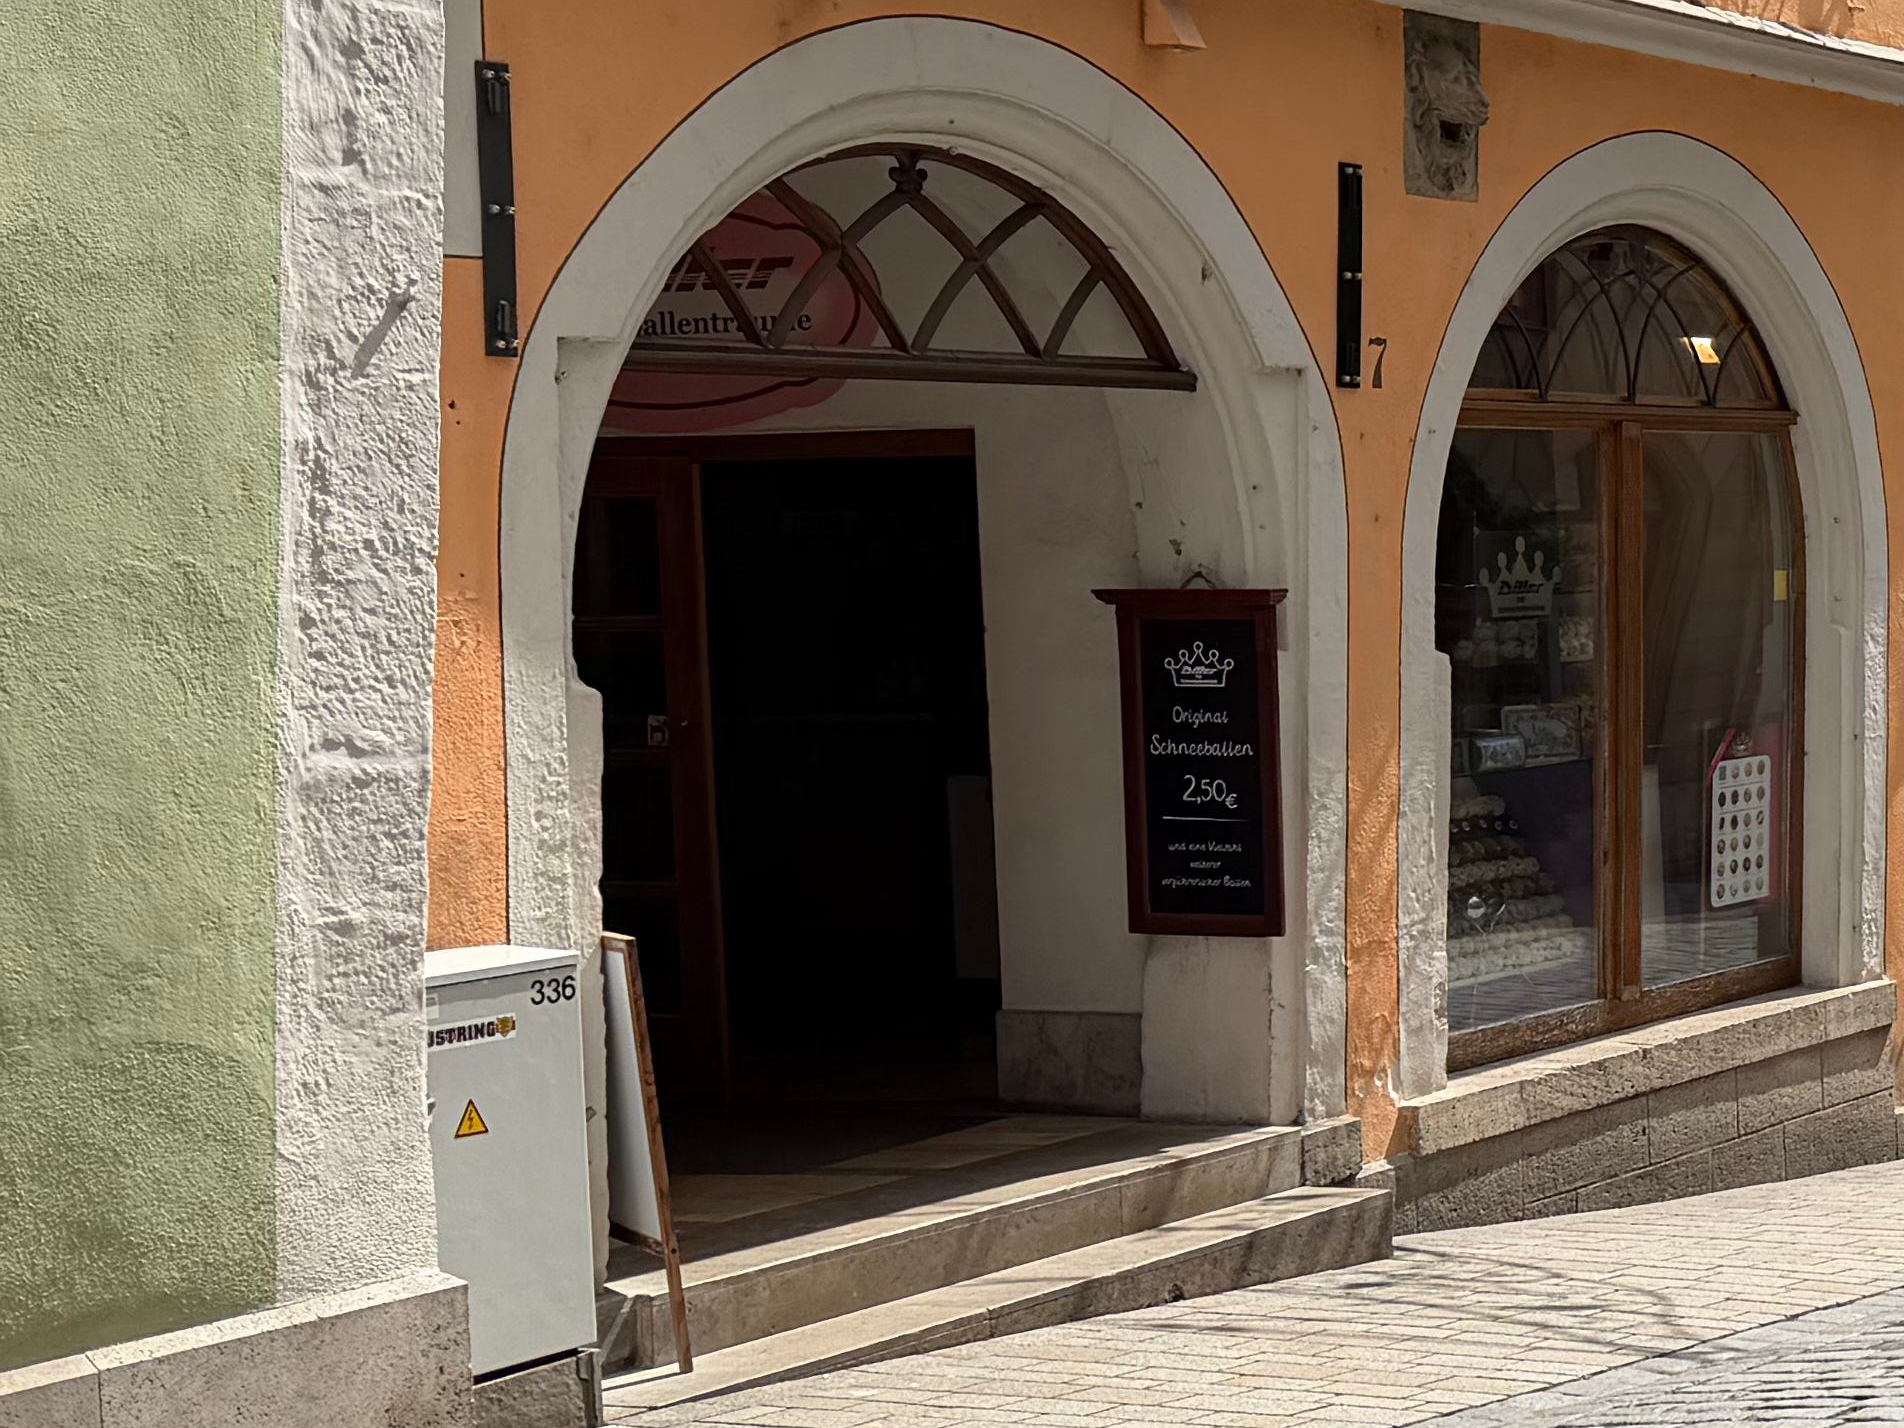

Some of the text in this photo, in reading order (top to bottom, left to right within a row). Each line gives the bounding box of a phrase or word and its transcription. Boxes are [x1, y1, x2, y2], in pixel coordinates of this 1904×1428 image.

[1367, 336, 1388, 389] 7
[1172, 705, 1230, 728] Original
[1150, 733, 1254, 757] Schneeballen
[530, 974, 577, 1006] 336
